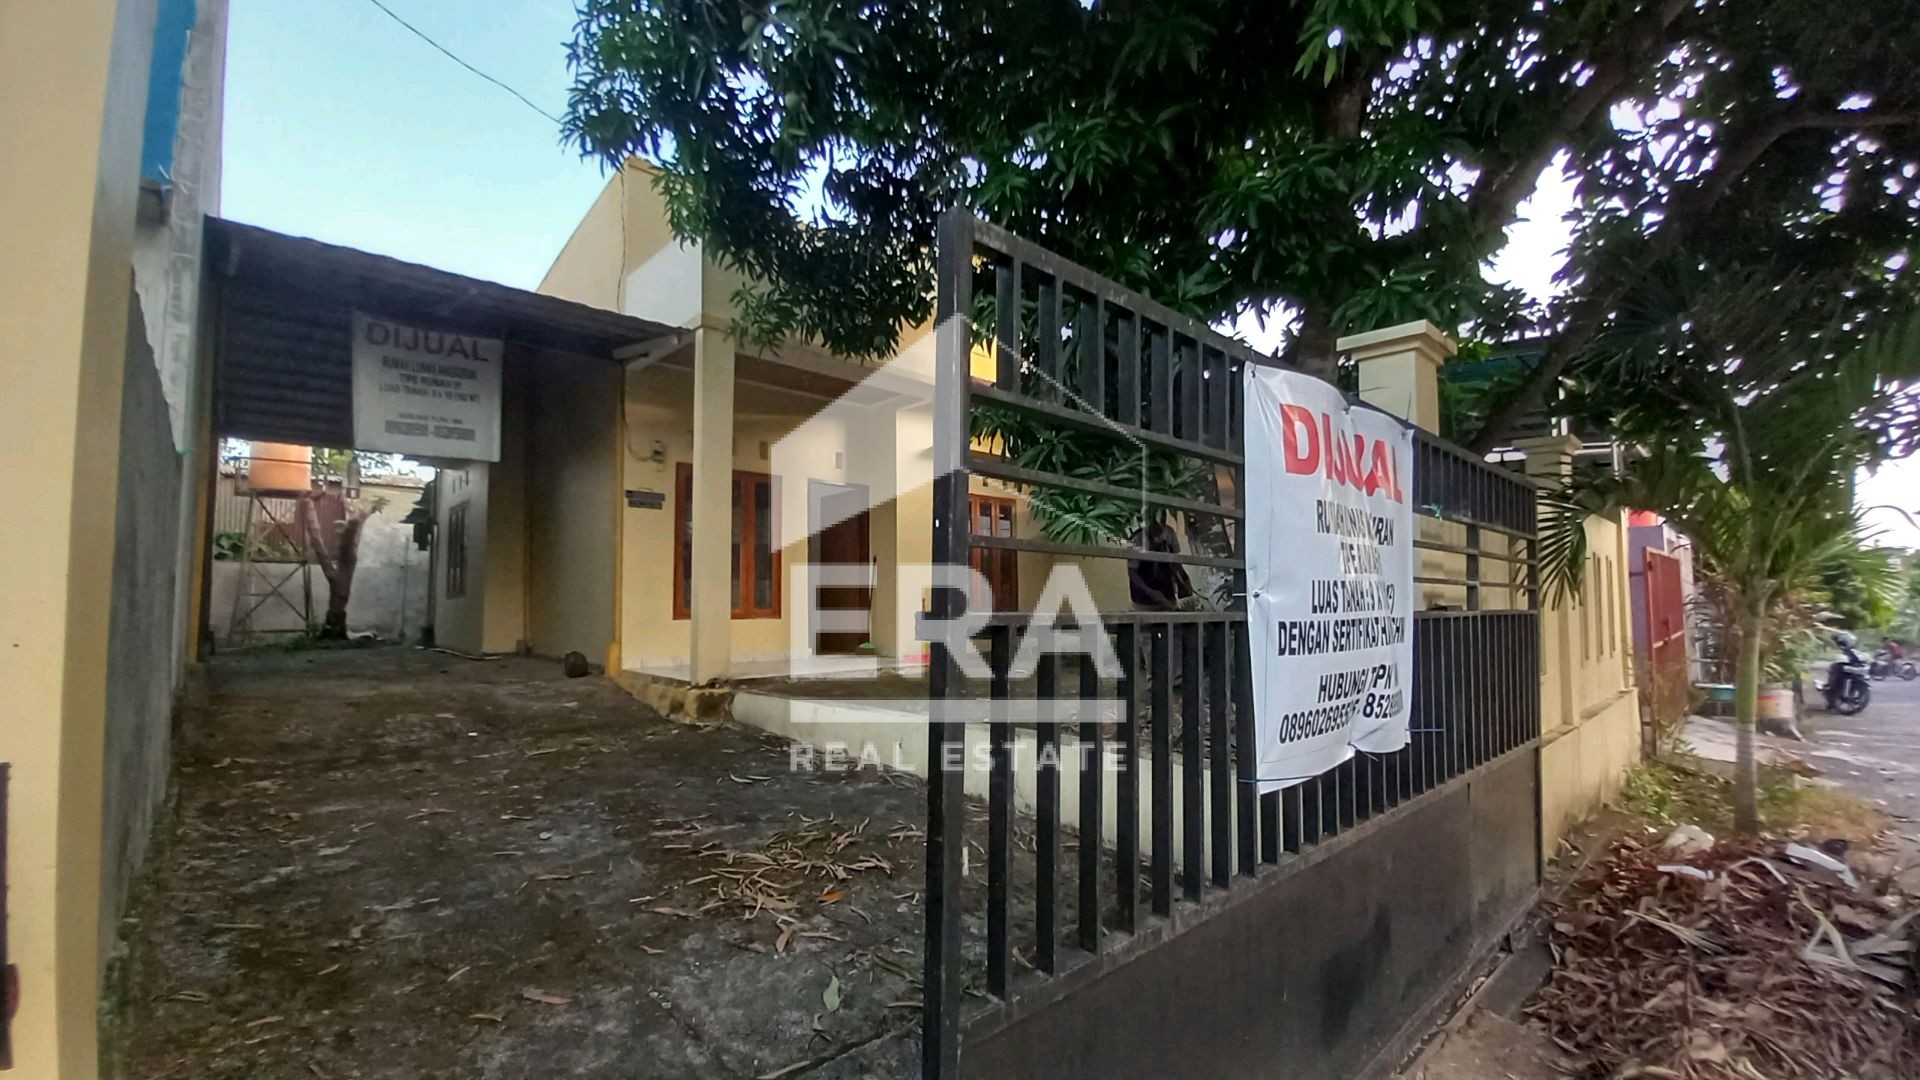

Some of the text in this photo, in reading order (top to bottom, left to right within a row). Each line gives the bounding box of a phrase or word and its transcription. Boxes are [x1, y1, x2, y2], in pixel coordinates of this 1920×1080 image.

[365, 322, 489, 362] DIJUAL
[1279, 403, 1403, 504] DIJUAL
[1311, 580, 1338, 614] LUAS
[1278, 619, 1329, 656] DENGAN
[1318, 668, 1369, 703] HUBUNGI
